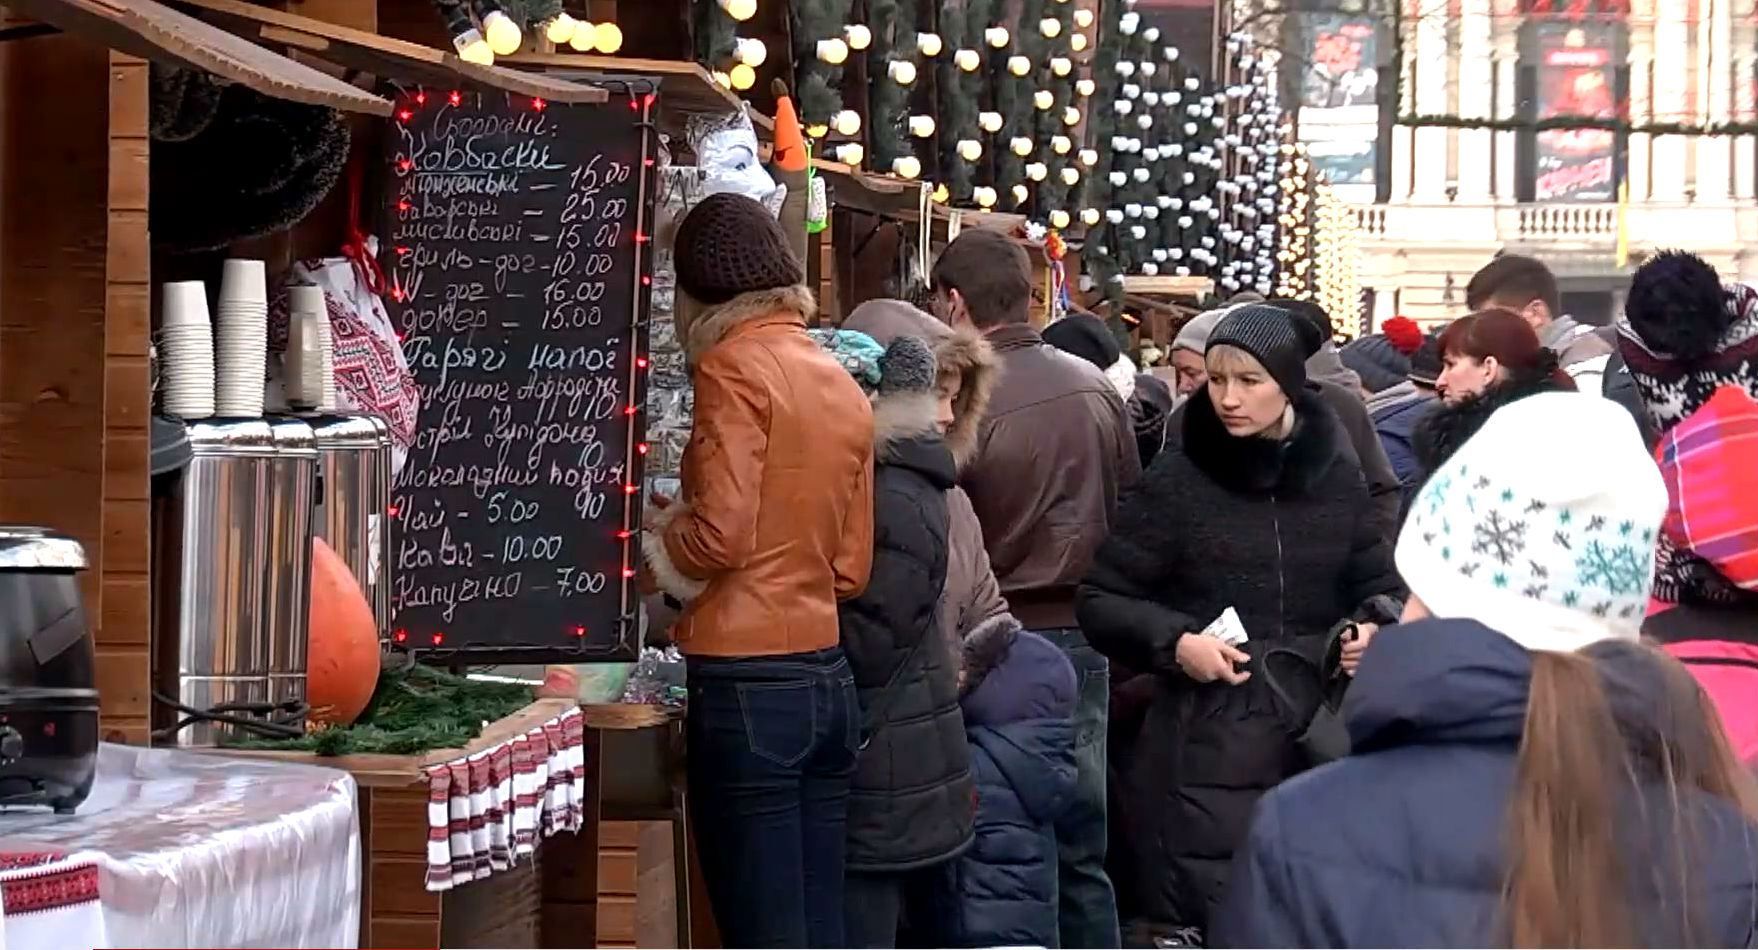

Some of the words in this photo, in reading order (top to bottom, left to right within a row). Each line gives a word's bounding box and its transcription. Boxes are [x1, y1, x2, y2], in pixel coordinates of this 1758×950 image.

[571, 154, 630, 191] 15.00
[561, 188, 627, 223] 25.00
[556, 222, 621, 249] 15.00
[552, 252, 613, 278] 10.00
[544, 278, 605, 305] 16.00
[542, 301, 602, 330] 15.00
[487, 491, 540, 523] 5.00
[398, 526, 473, 569] Кава
[503, 535, 563, 564] 10.00
